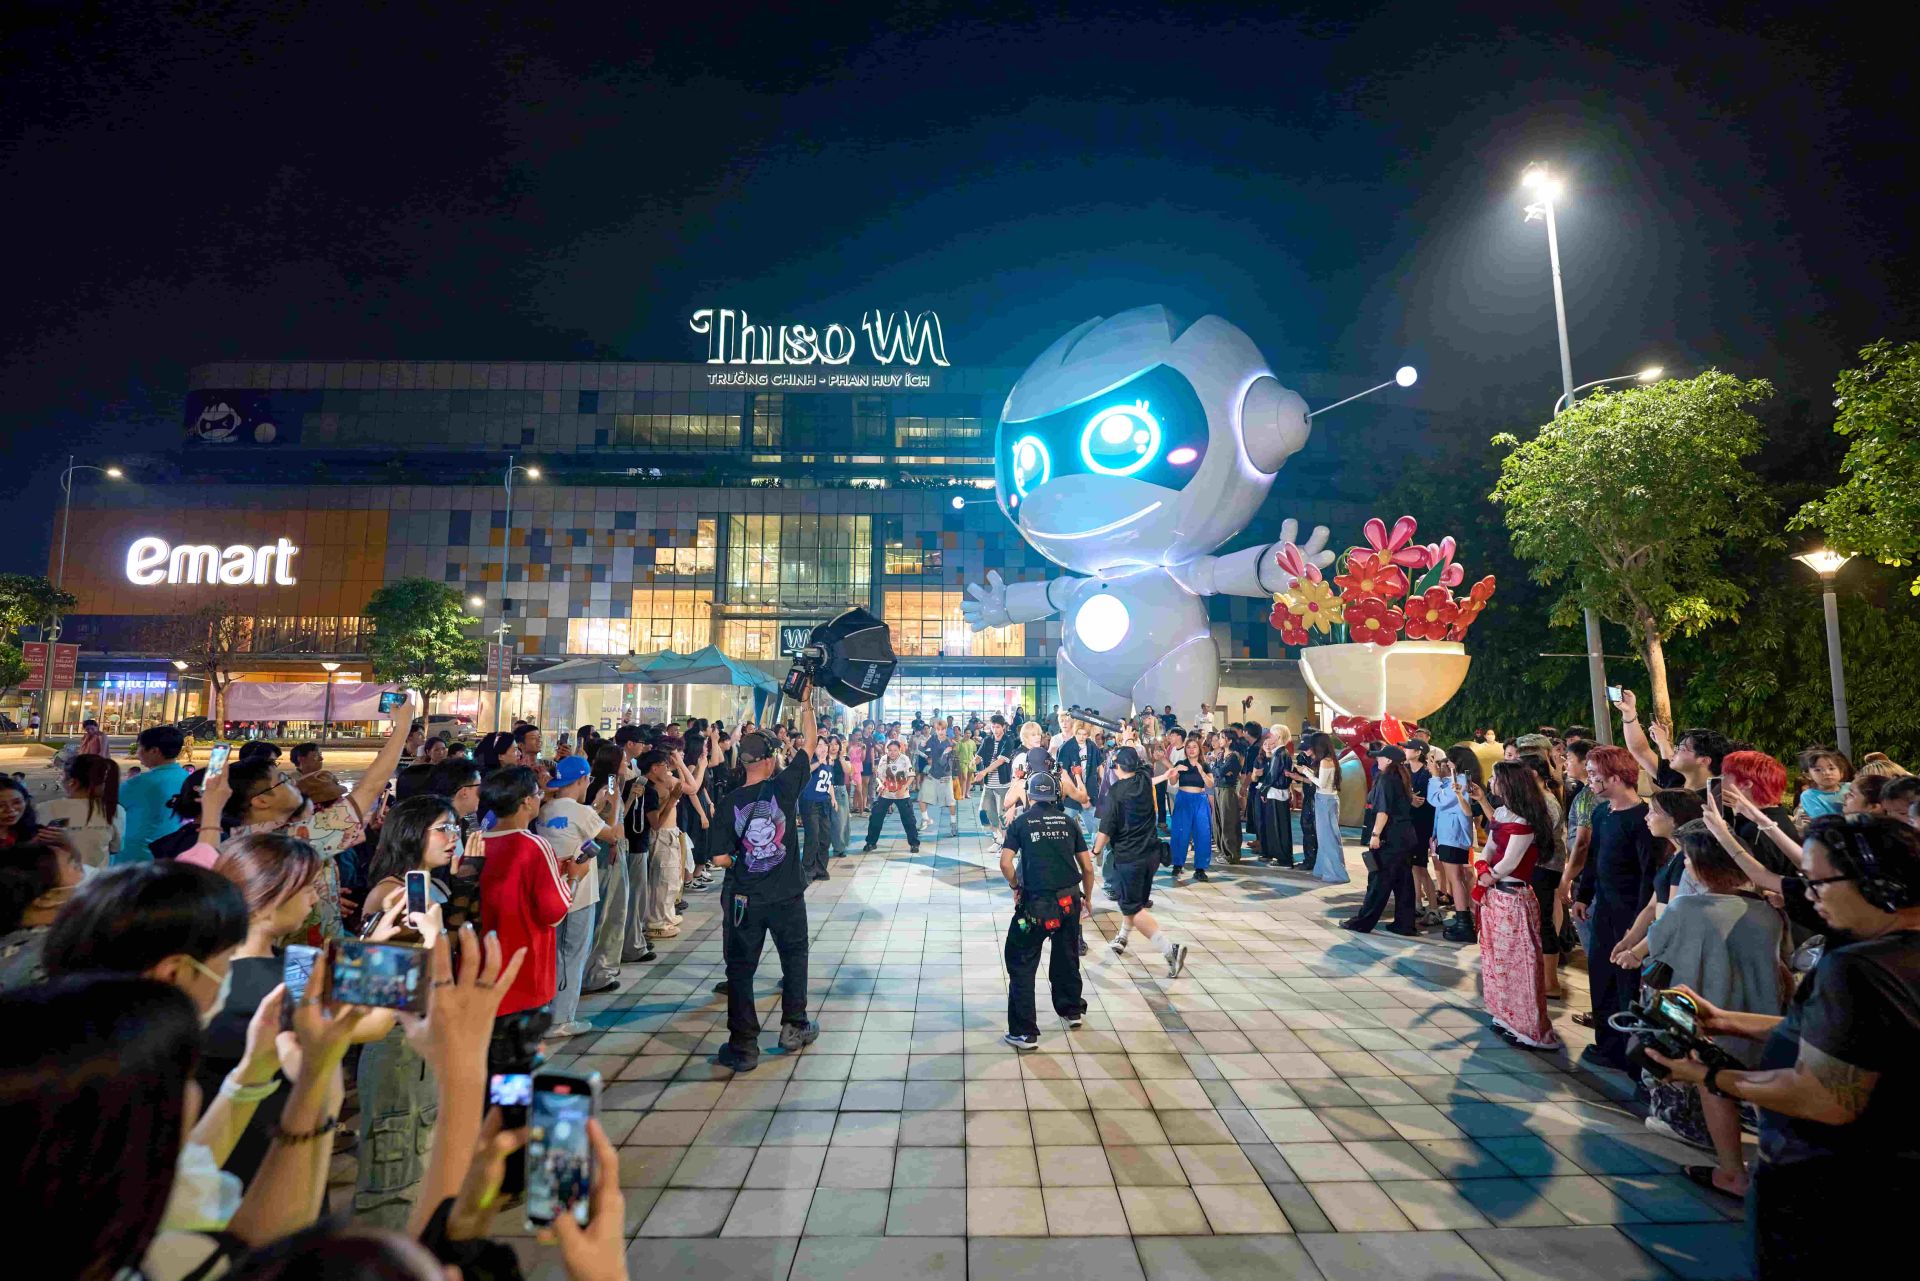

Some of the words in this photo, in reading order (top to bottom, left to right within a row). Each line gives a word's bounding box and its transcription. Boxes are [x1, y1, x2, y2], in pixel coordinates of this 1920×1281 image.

[689, 308, 856, 365] Thiso
[707, 370, 768, 385] TRƯỜNG
[771, 374, 817, 386] CHINH
[828, 374, 869, 386] PHAN
[872, 375, 902, 387] HUY
[905, 371, 930, 387] ÍCH
[126, 537, 299, 585] emart
